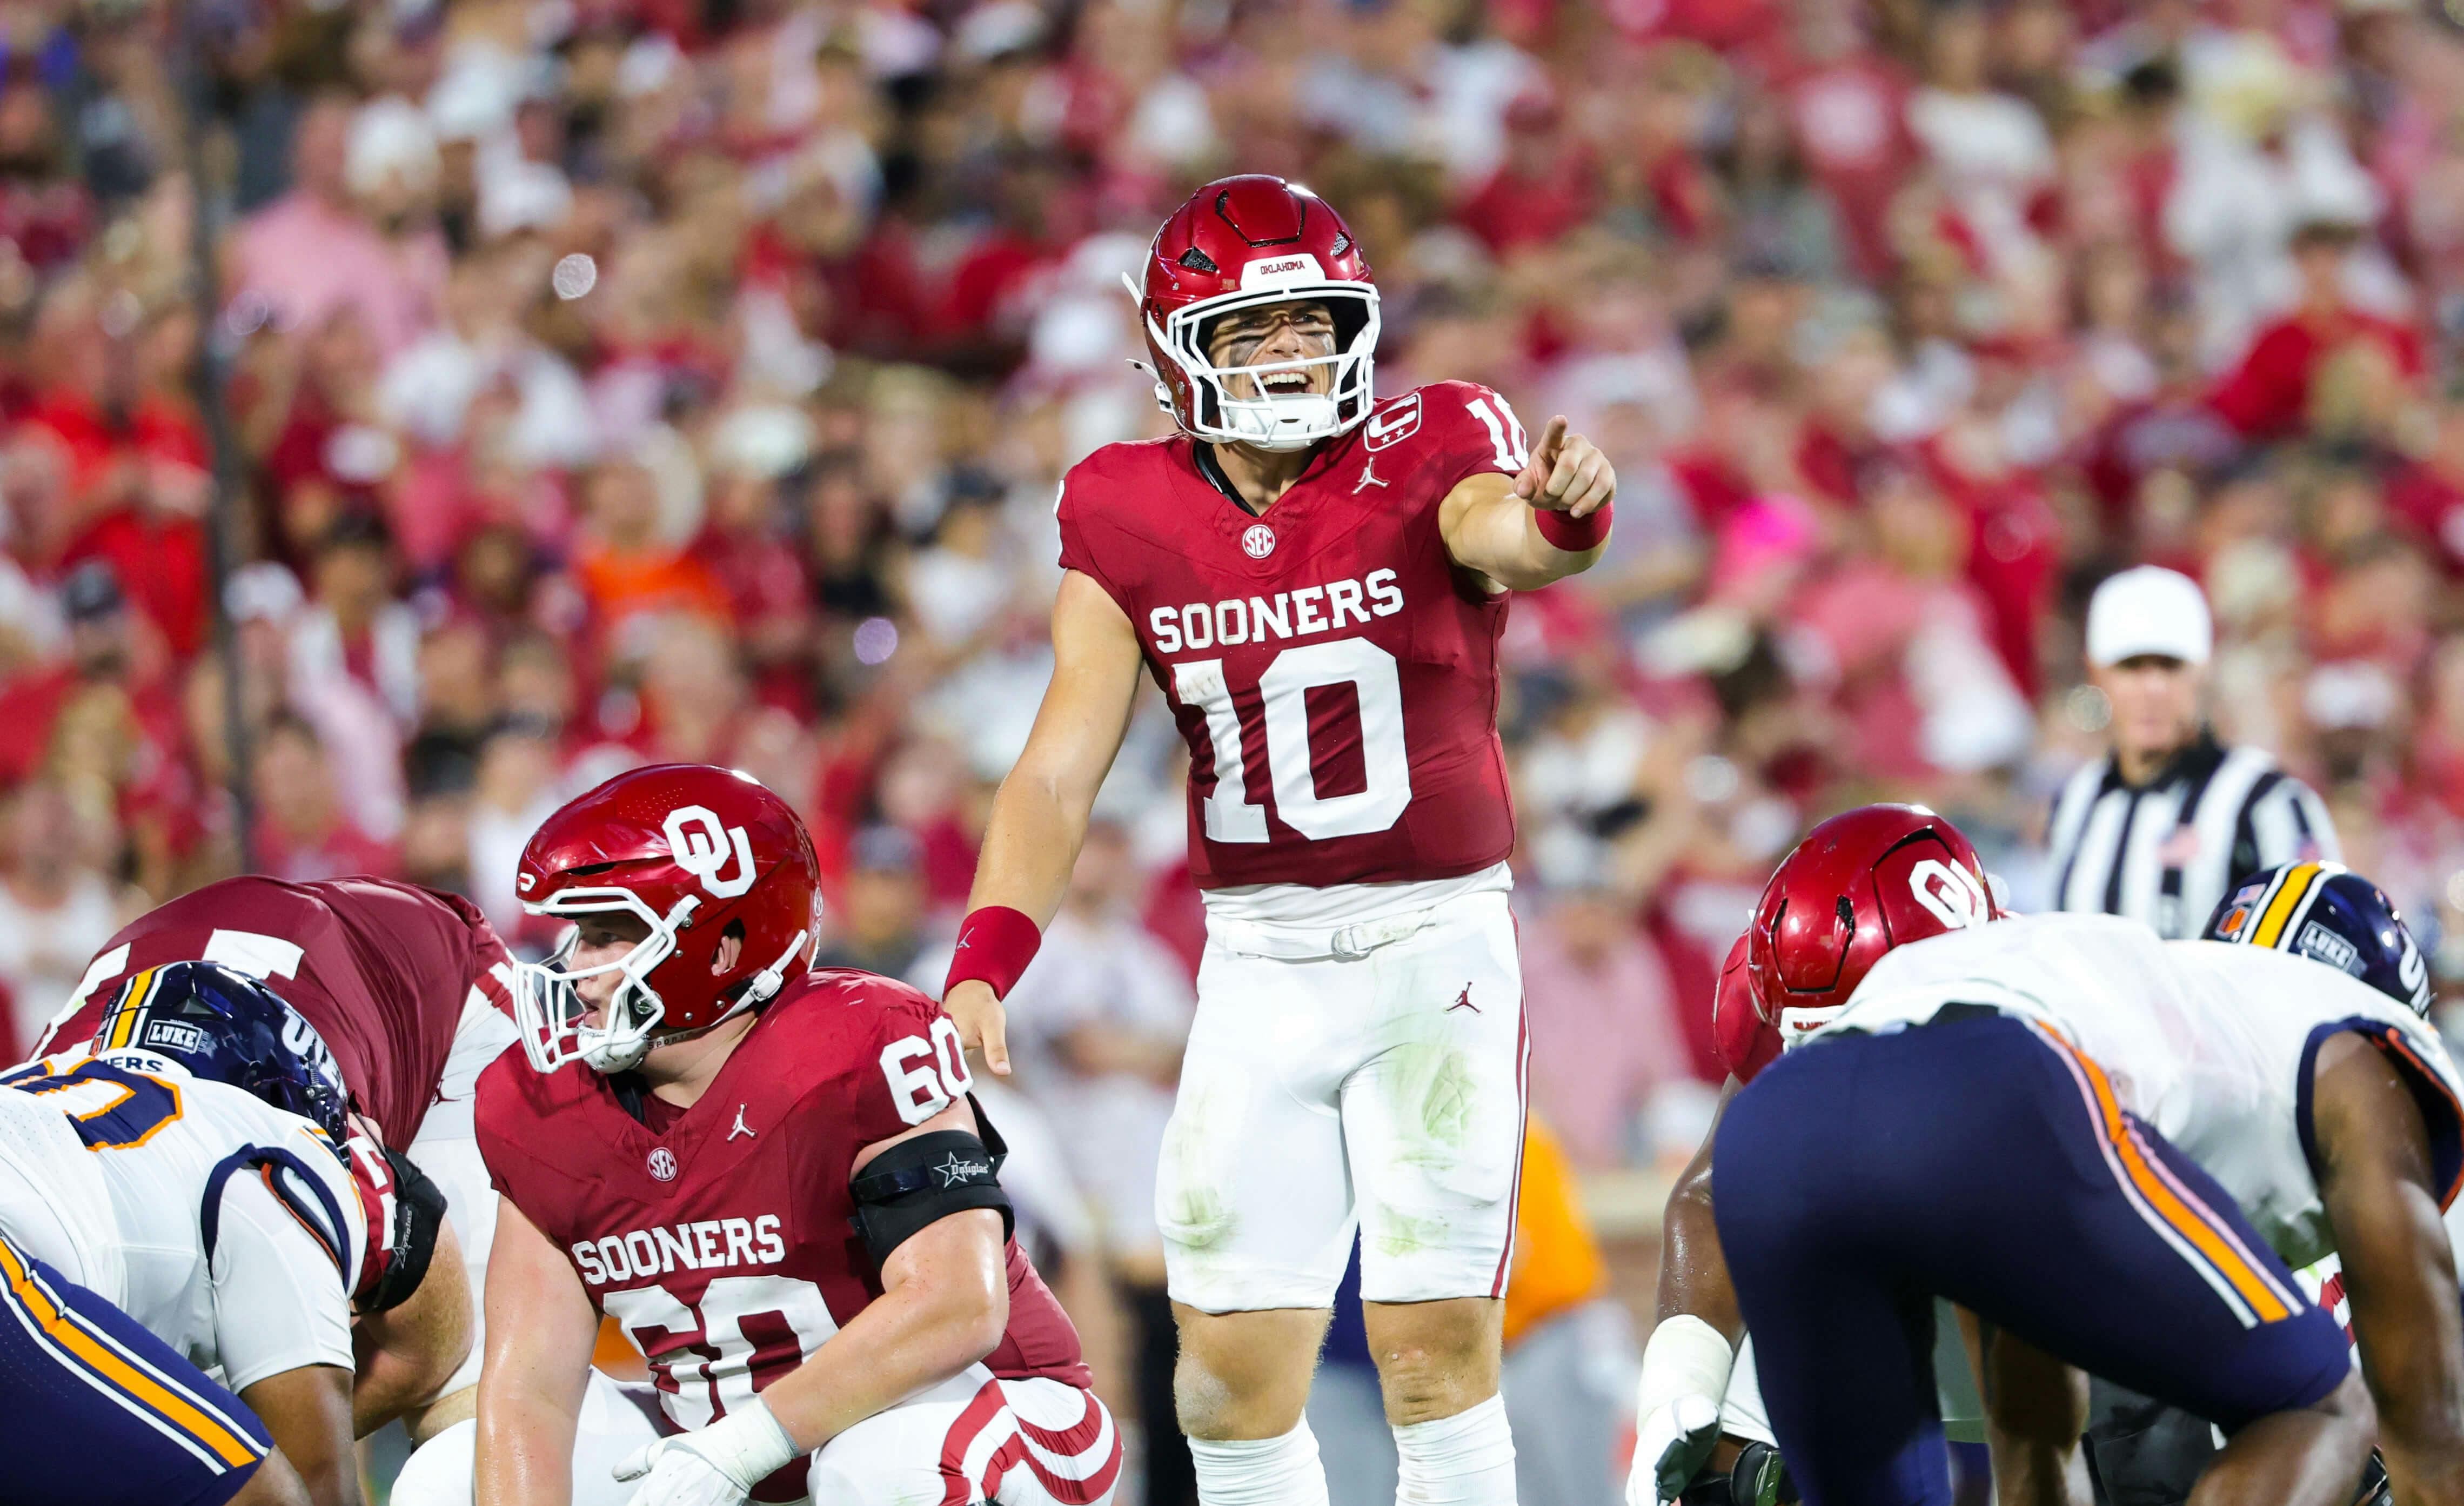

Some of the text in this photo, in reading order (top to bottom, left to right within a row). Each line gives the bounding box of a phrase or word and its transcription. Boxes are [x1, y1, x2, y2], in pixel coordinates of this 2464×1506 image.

[1260, 260, 1305, 275] OKLAHOMA
[1244, 527, 1272, 555] SEC
[1150, 567, 1404, 653] SOONERS
[1171, 637, 1412, 843] 10
[661, 805, 756, 899] OU
[2302, 926, 2352, 967] LUKE
[150, 1024, 197, 1048] LUKE
[104, 1056, 164, 1072] ERS
[879, 1015, 974, 1127] 60
[650, 1150, 675, 1179] SEC
[951, 1162, 988, 1176] Douglas
[571, 1214, 786, 1285] SOONERS
[603, 1274, 841, 1433] 60
